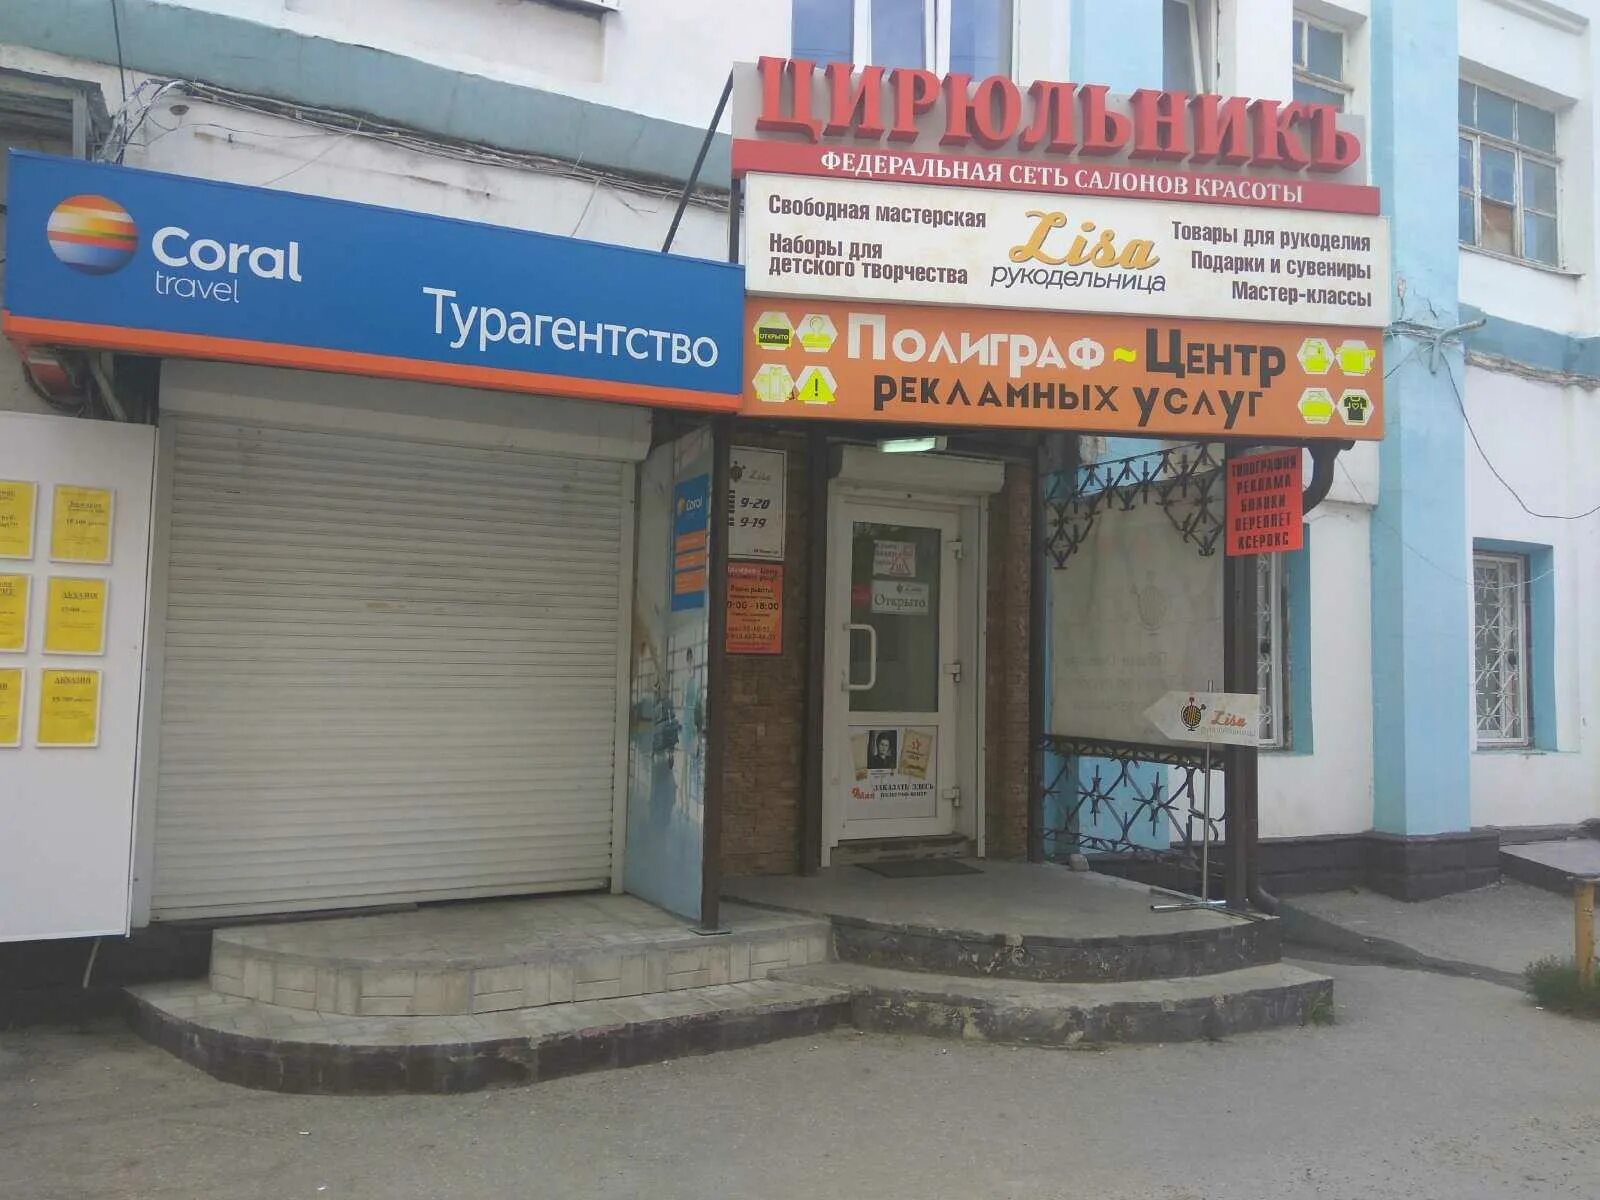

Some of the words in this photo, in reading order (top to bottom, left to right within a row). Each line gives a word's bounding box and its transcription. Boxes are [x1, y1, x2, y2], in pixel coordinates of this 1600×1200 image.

[755, 55, 1361, 174] ЦИРЮЛЬНИКЪ
[820, 151, 1002, 184] ФЕДЕРАЛЬНАЯ
[1008, 164, 1069, 187] СЕТЬ
[1074, 168, 1188, 196] САЛОНОВ
[1195, 177, 1303, 204] КРАСОТЫ
[768, 194, 870, 222] Свободная
[875, 205, 987, 228] мастерская
[769, 232, 843, 258] Наборы
[849, 242, 883, 261] для
[1008, 209, 1161, 271] Lisa
[1171, 220, 1238, 245] Товары
[1243, 228, 1275, 248] для
[1280, 230, 1371, 252] рукоделия
[152, 226, 303, 282] Coral
[769, 256, 855, 277] детского
[861, 262, 968, 285] творчества
[1191, 250, 1265, 274] Подарки
[1270, 258, 1281, 274] и
[1286, 259, 1371, 280] сувениры
[155, 270, 240, 304] travel
[990, 265, 1167, 294] рукодельница
[1231, 280, 1372, 308] Мастер-классы
[422, 286, 720, 368] Турагентство
